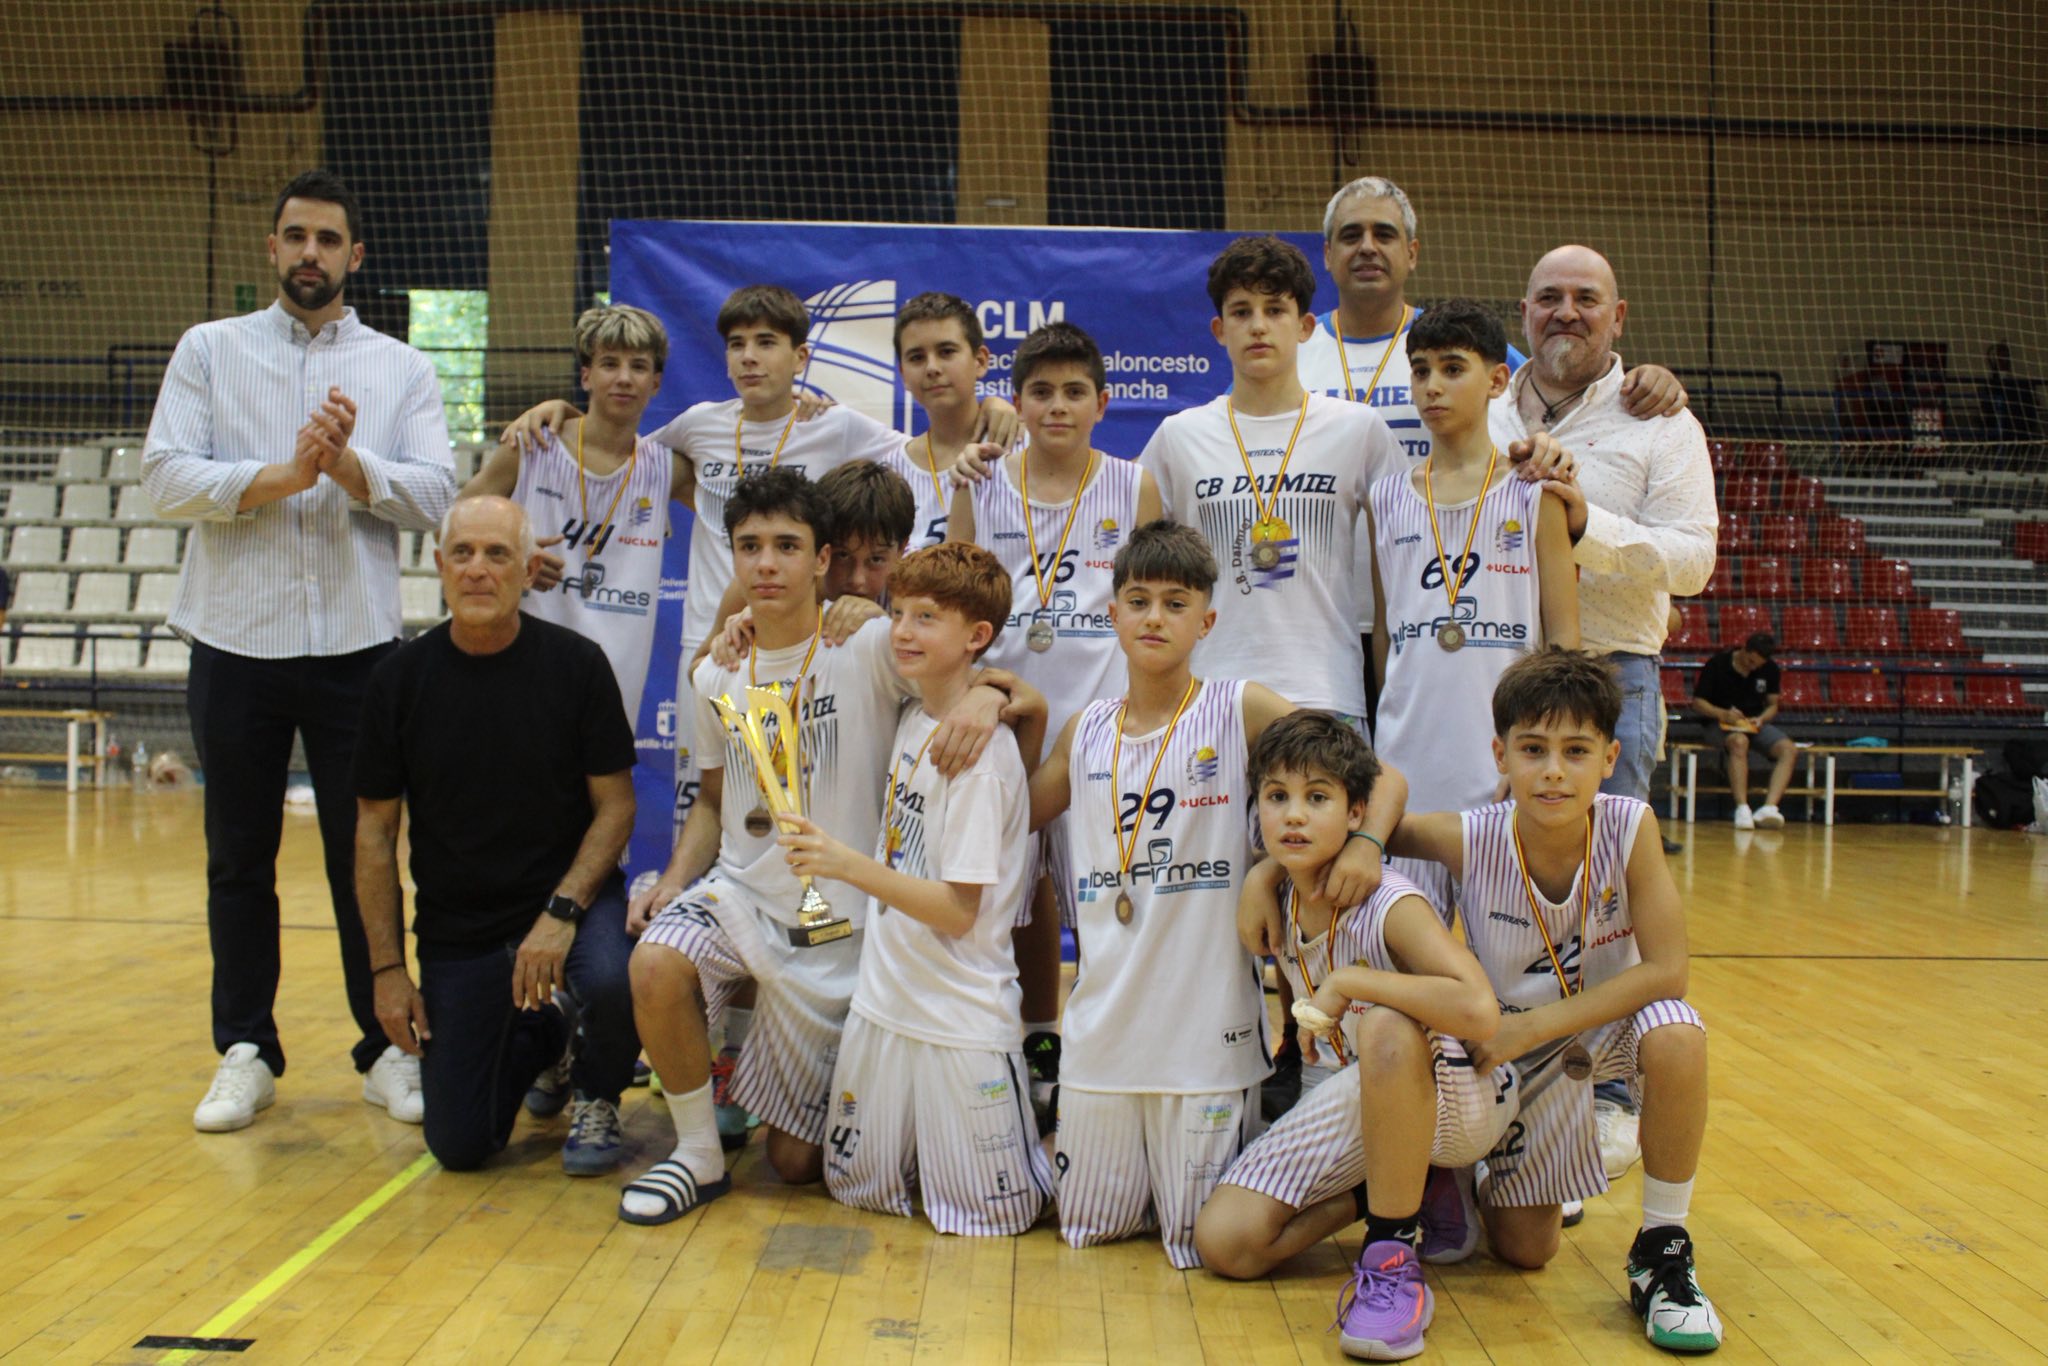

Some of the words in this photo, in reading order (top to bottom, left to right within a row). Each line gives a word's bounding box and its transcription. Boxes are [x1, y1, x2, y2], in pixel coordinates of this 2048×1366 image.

[970, 300, 1065, 339] CLM
[1104, 351, 1210, 373] aloncesto
[1104, 378, 1168, 400] ancha
[1195, 477, 1224, 499] CB
[1232, 473, 1337, 494] DAIMIEL
[561, 518, 615, 555] 44
[1025, 549, 1081, 583] 46
[1093, 560, 1115, 570] UCL
[1421, 552, 1481, 590] 69
[1494, 564, 1531, 575] UCLM
[1113, 788, 1176, 834] 29
[1188, 795, 1229, 808] UCLM
[1596, 926, 1634, 947] UCLM
[1524, 935, 1586, 976] 22
[1223, 1031, 1237, 1044] 14
